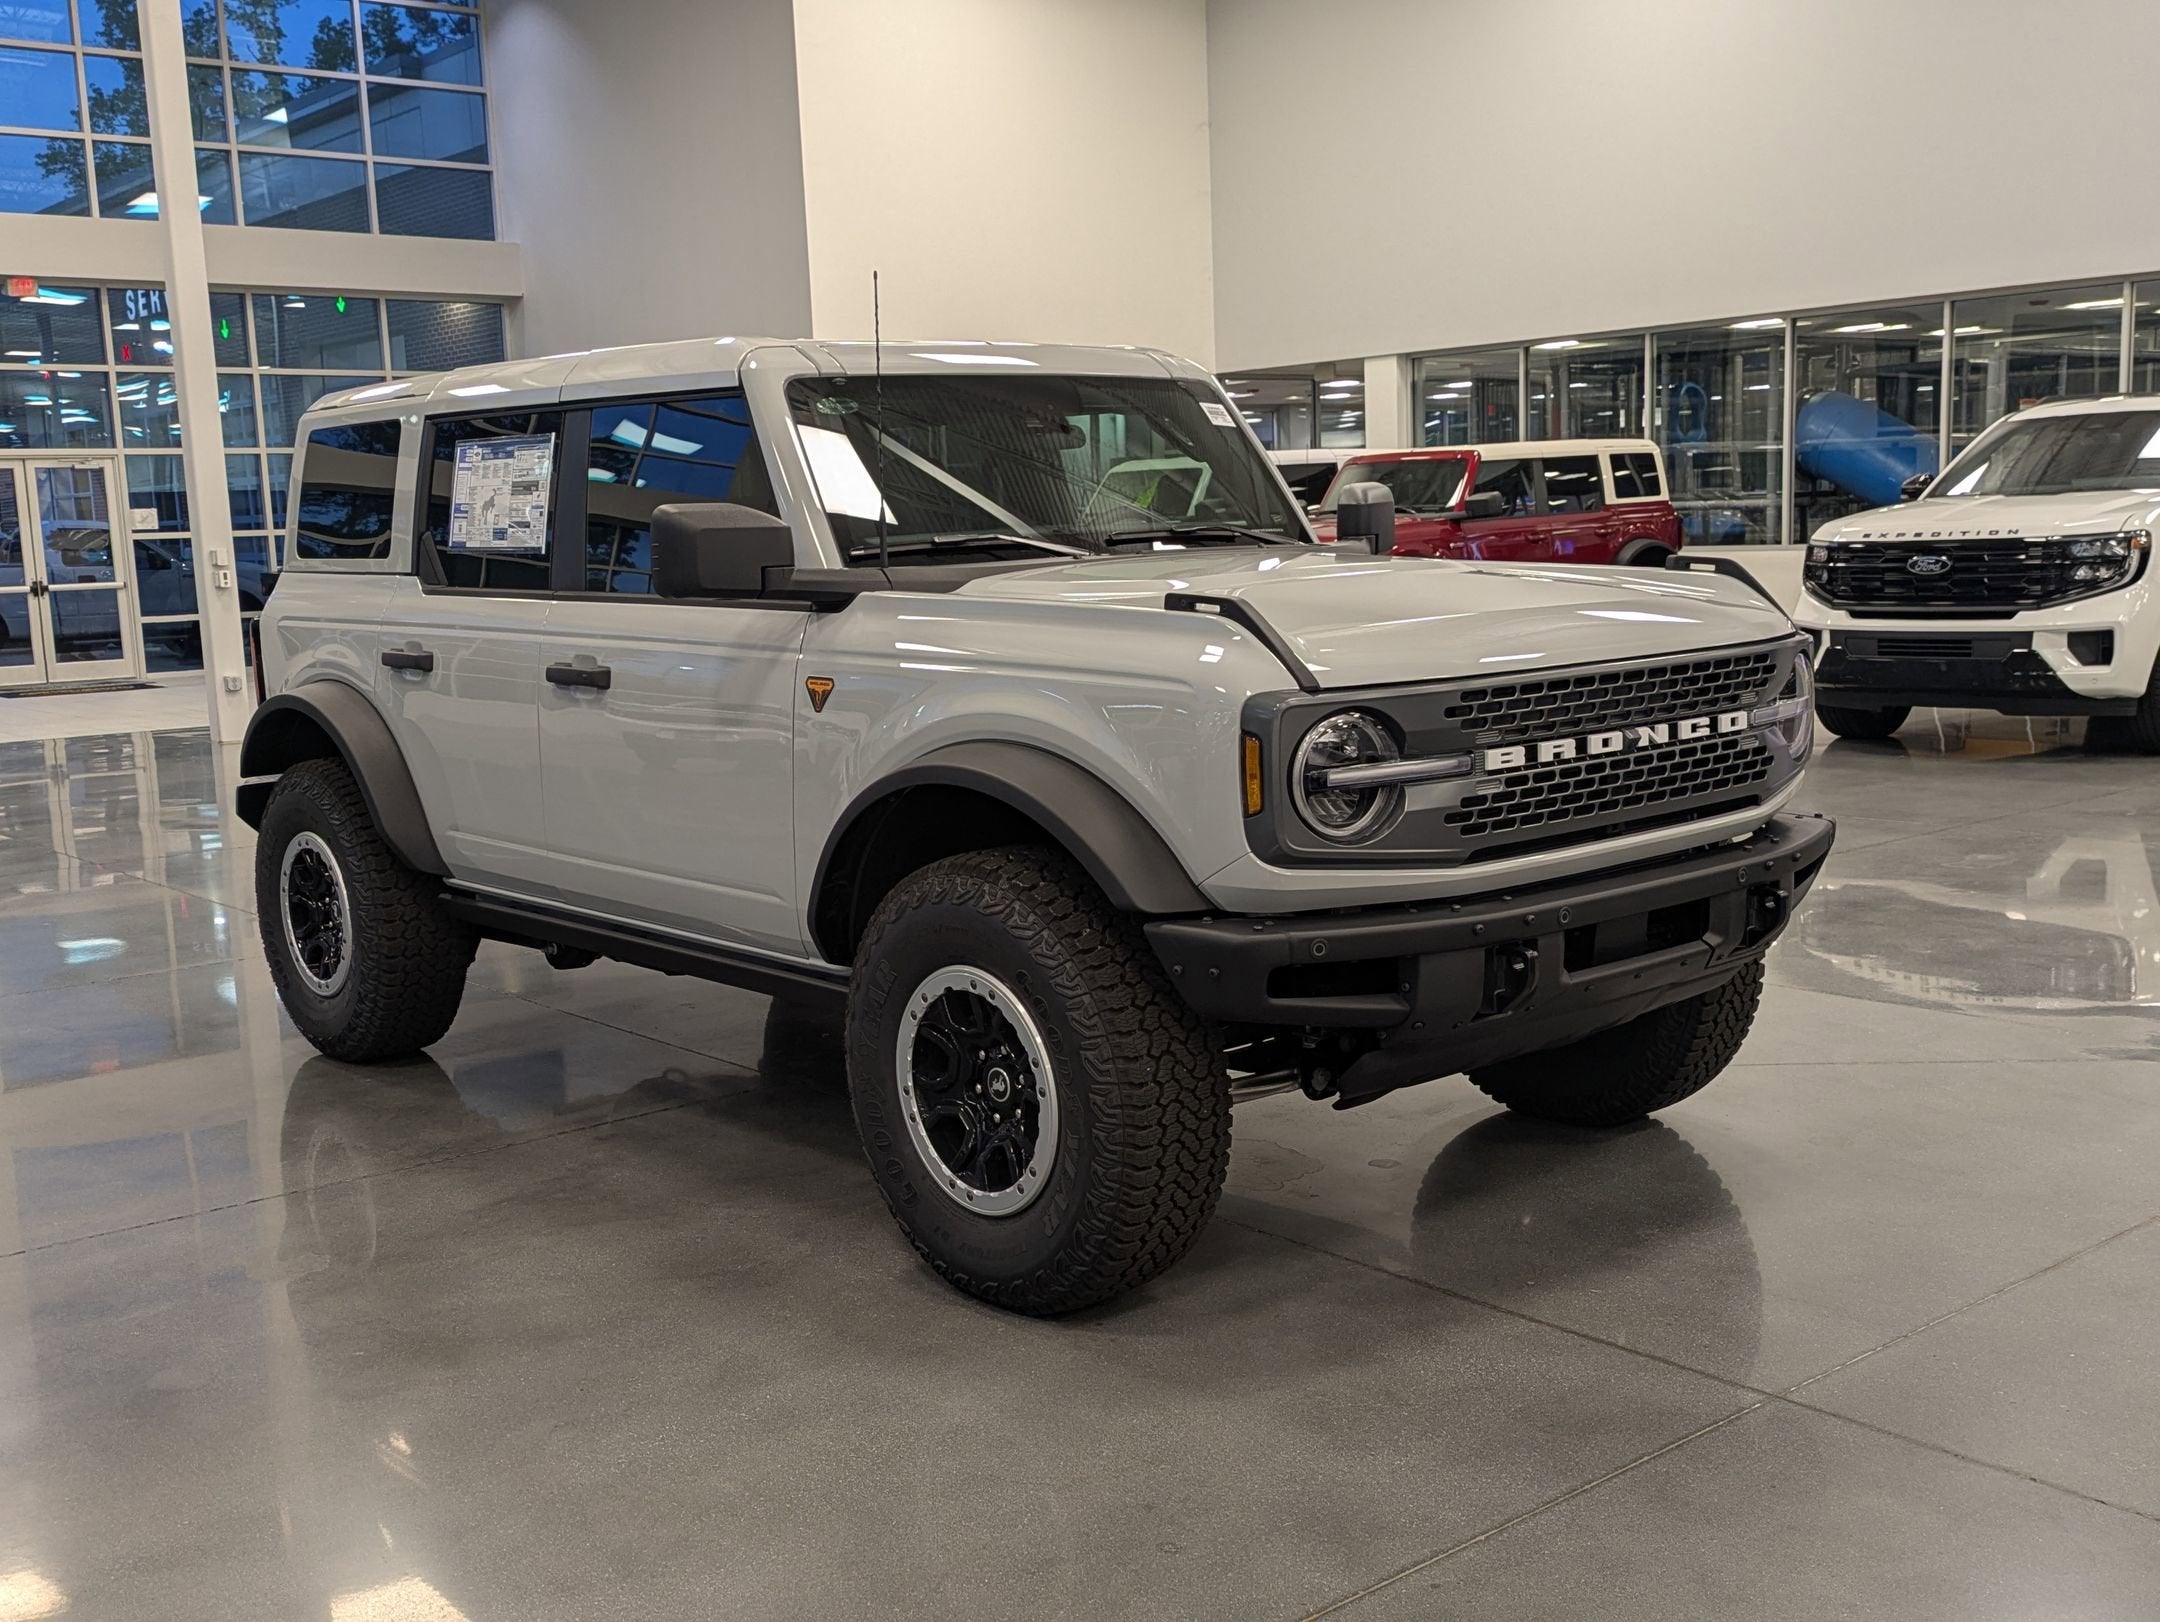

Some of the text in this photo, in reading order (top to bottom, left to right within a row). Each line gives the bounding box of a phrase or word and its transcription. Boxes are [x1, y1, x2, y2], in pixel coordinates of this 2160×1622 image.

[1862, 529, 2020, 539] EXPEDITION
[1914, 559, 1942, 572] Ford
[1484, 710, 1748, 771] BRONCO
